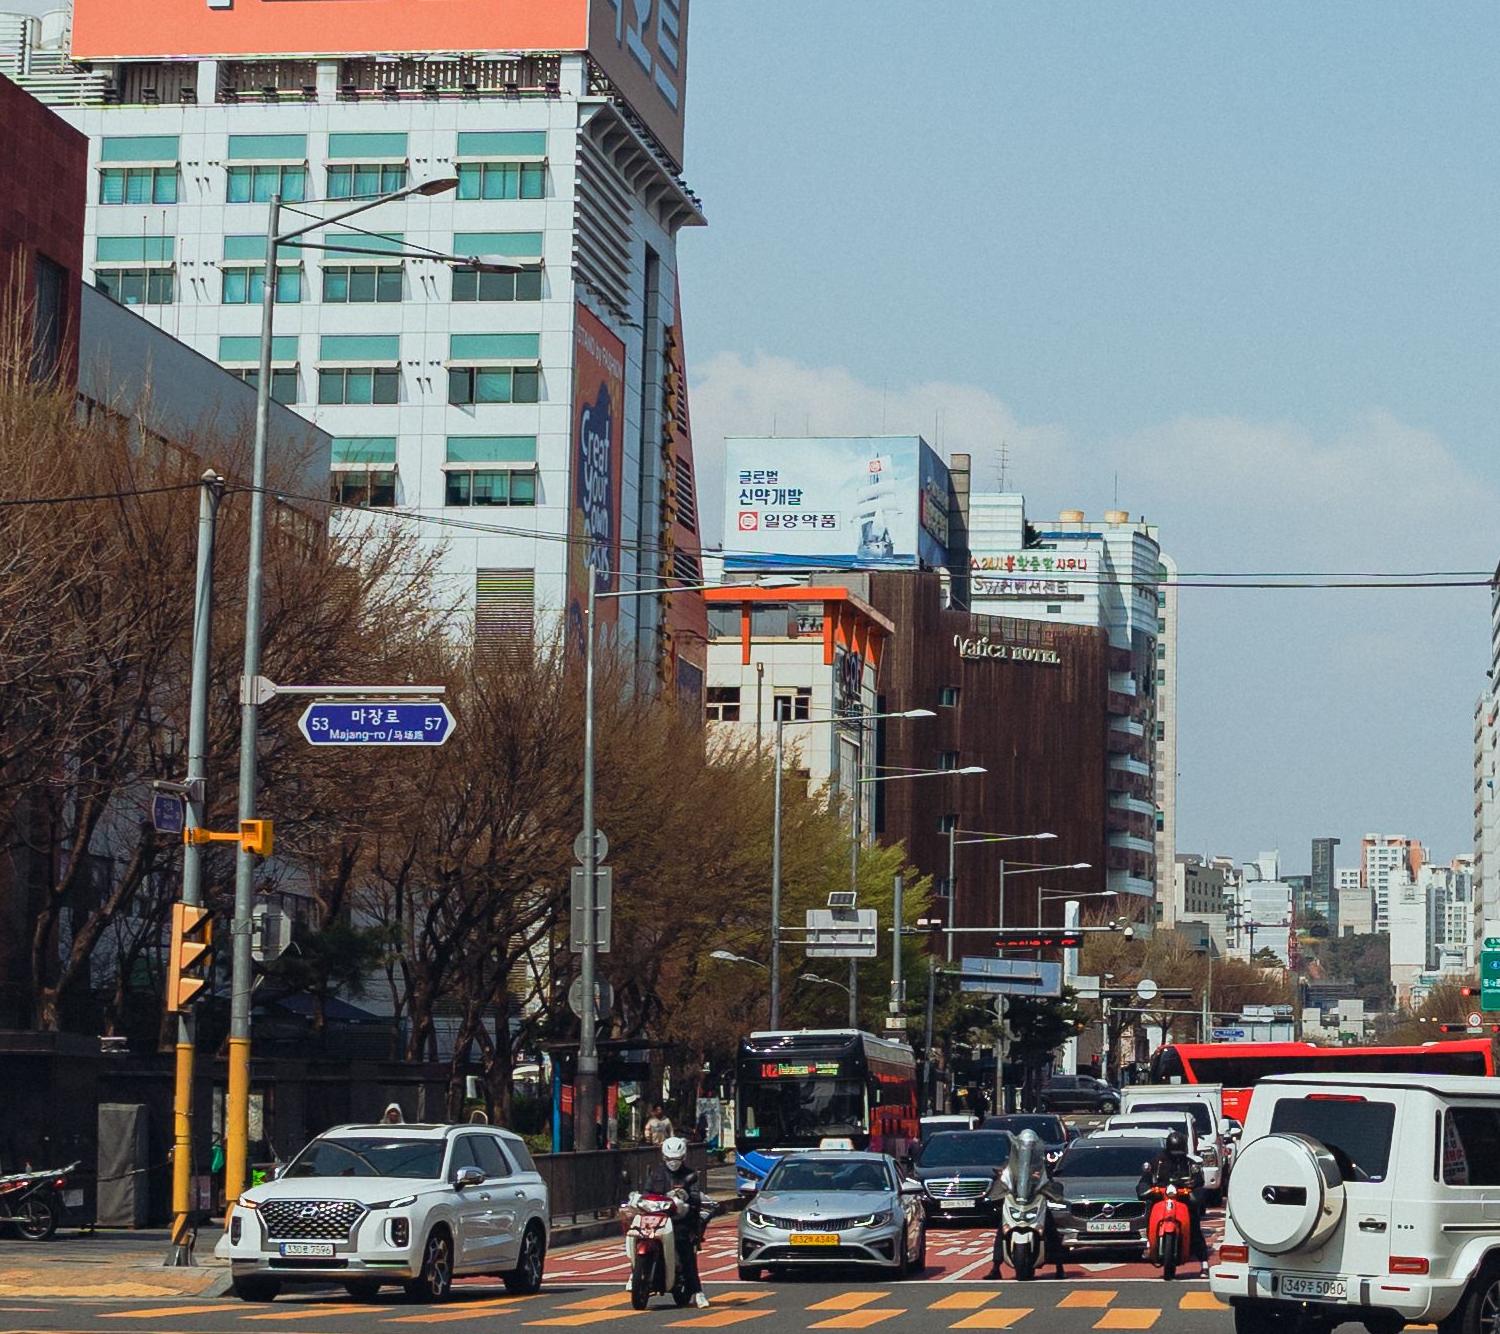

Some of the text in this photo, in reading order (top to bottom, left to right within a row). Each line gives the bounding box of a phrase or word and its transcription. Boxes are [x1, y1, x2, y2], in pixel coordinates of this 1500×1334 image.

[739, 470, 779, 485] 글로벌
[739, 488, 803, 506] 신약개발
[764, 513, 836, 529] 일양약품
[1011, 645, 1061, 665] HOTEL
[311, 717, 329, 731] 53
[351, 708, 400, 726] 마장로
[424, 717, 442, 731] 57
[329, 729, 386, 742] Majang-ro
[1315, 1280, 1343, 1296] 5080
